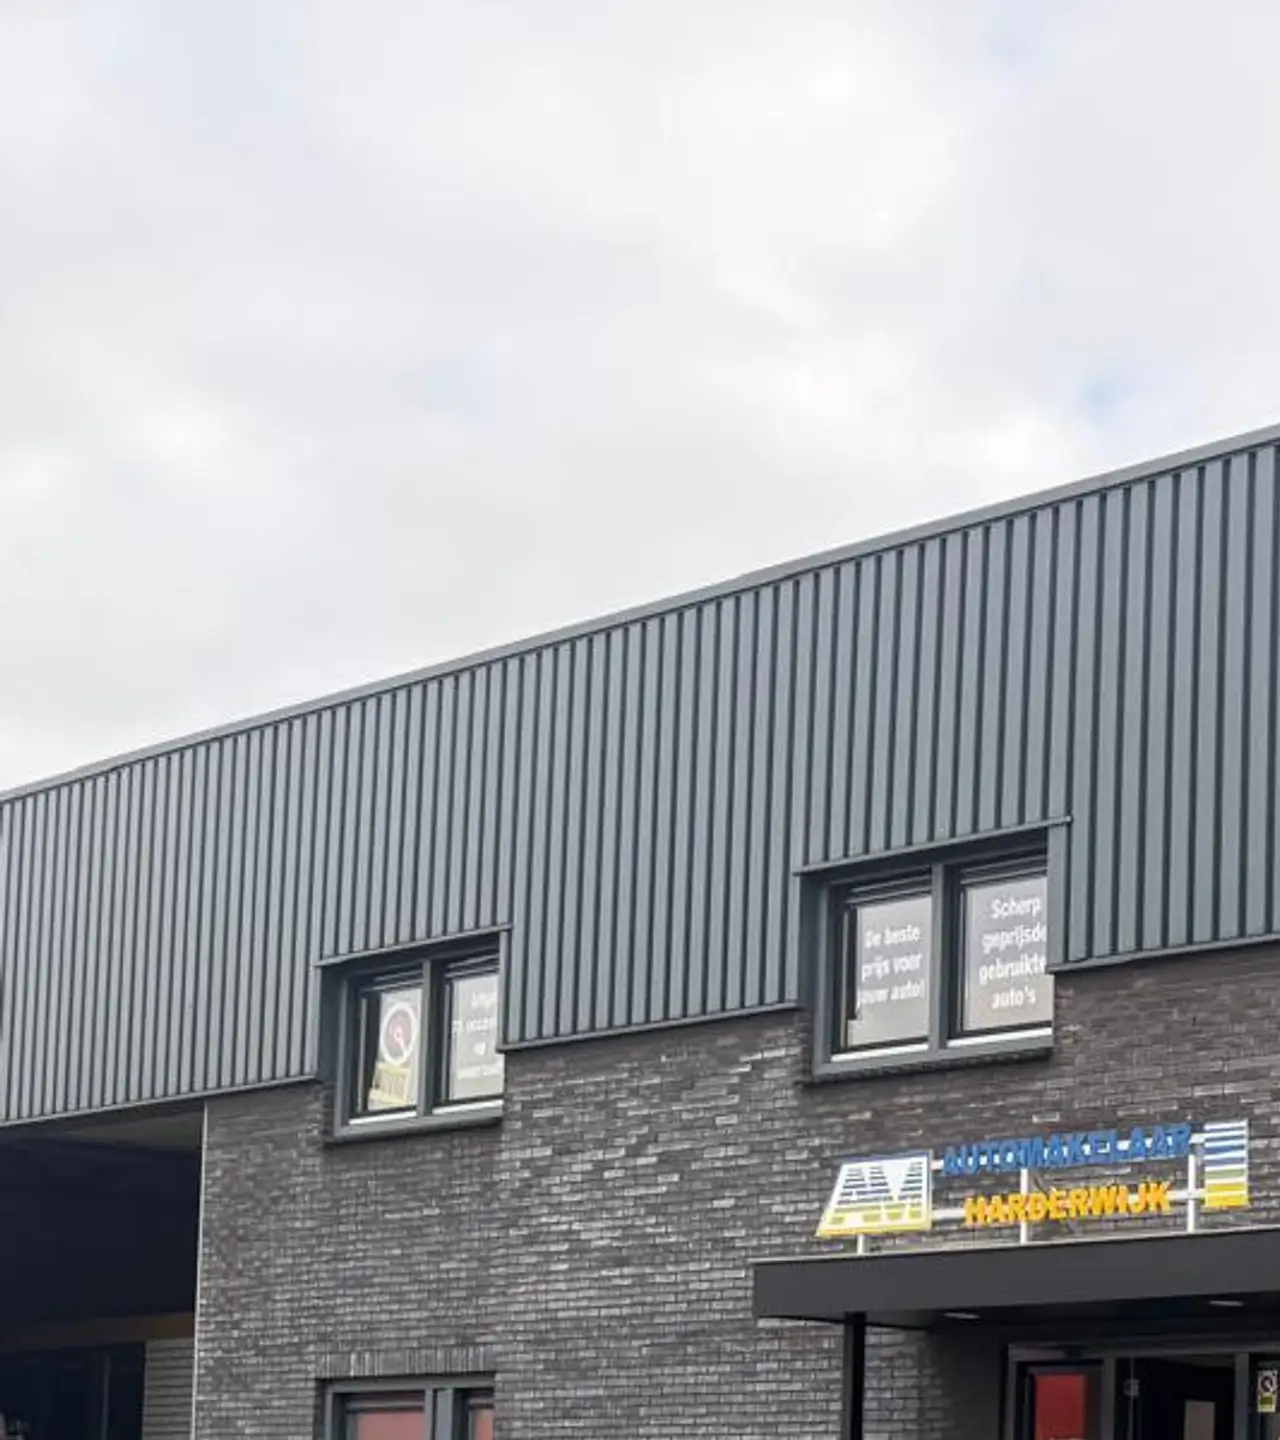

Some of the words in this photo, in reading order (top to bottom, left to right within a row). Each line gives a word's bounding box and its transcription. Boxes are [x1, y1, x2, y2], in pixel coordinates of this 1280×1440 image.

[990, 897, 1042, 920] Scherp
[990, 985, 1037, 1010] auto's
[941, 1122, 1194, 1176] AUTOMAKELAAR
[964, 1181, 1175, 1230] HARDERWIJK
